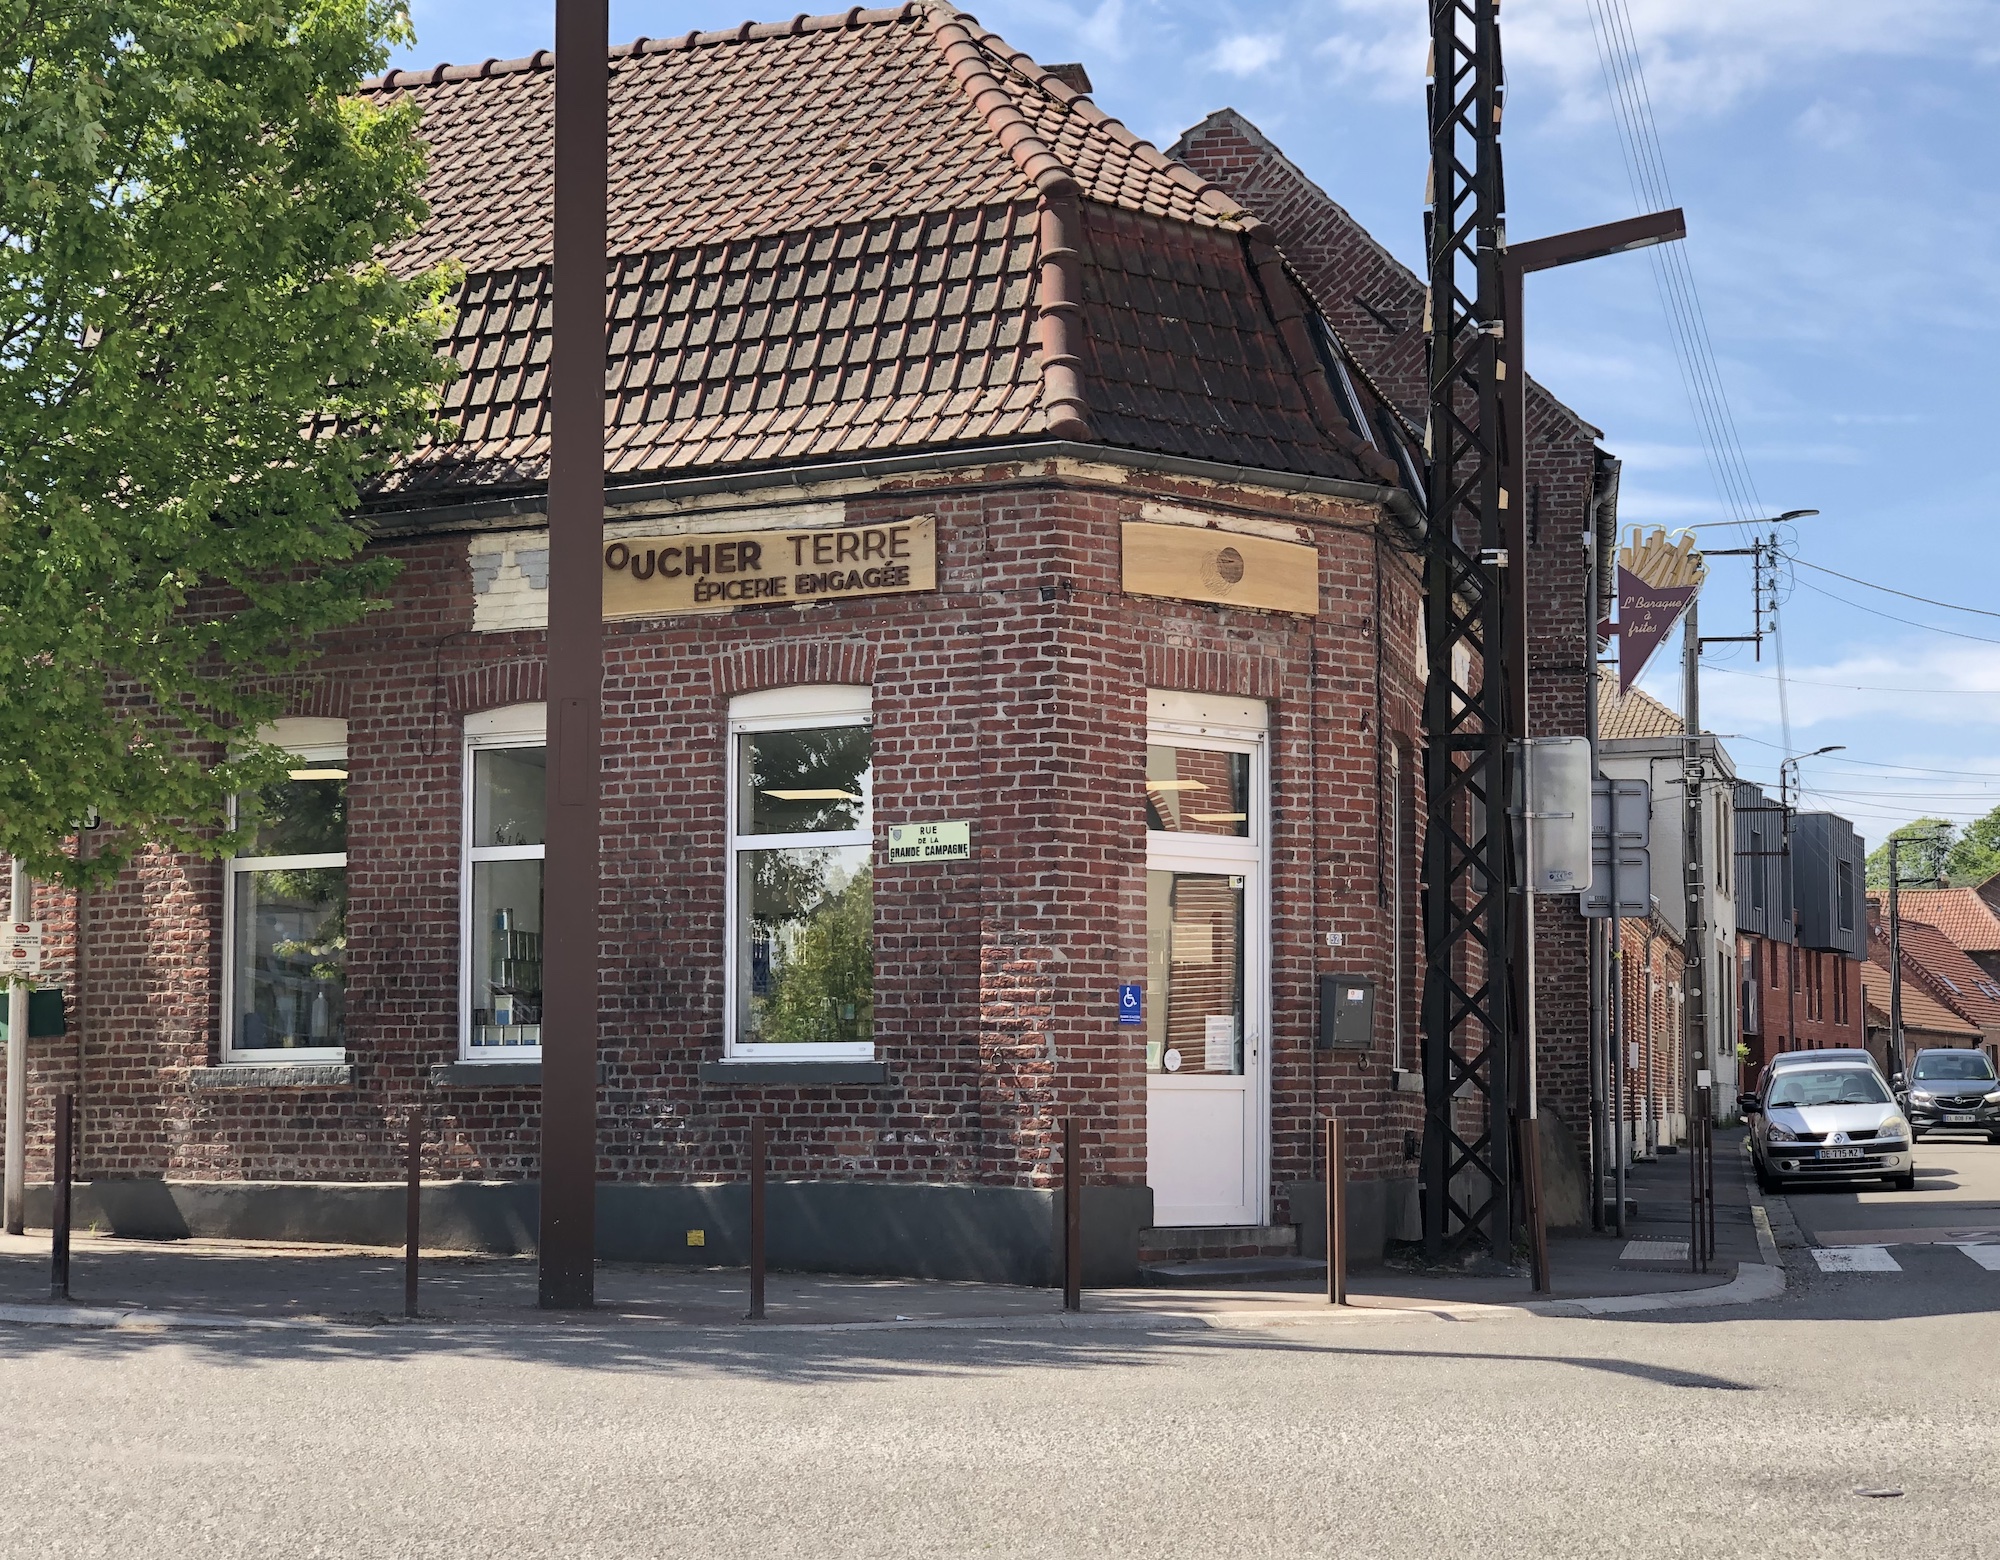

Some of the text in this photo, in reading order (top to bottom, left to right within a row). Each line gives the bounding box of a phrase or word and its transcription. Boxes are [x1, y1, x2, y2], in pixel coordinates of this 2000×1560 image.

[605, 526, 911, 580] OUCHER TERRE
[693, 560, 910, 602] ÉPICERIE ENGAGÉE
[1643, 610, 1652, 620] à
[1628, 621, 1657, 637] frites
[920, 826, 937, 835] RUE
[890, 843, 968, 858] GRANDE CAMPAGNE
